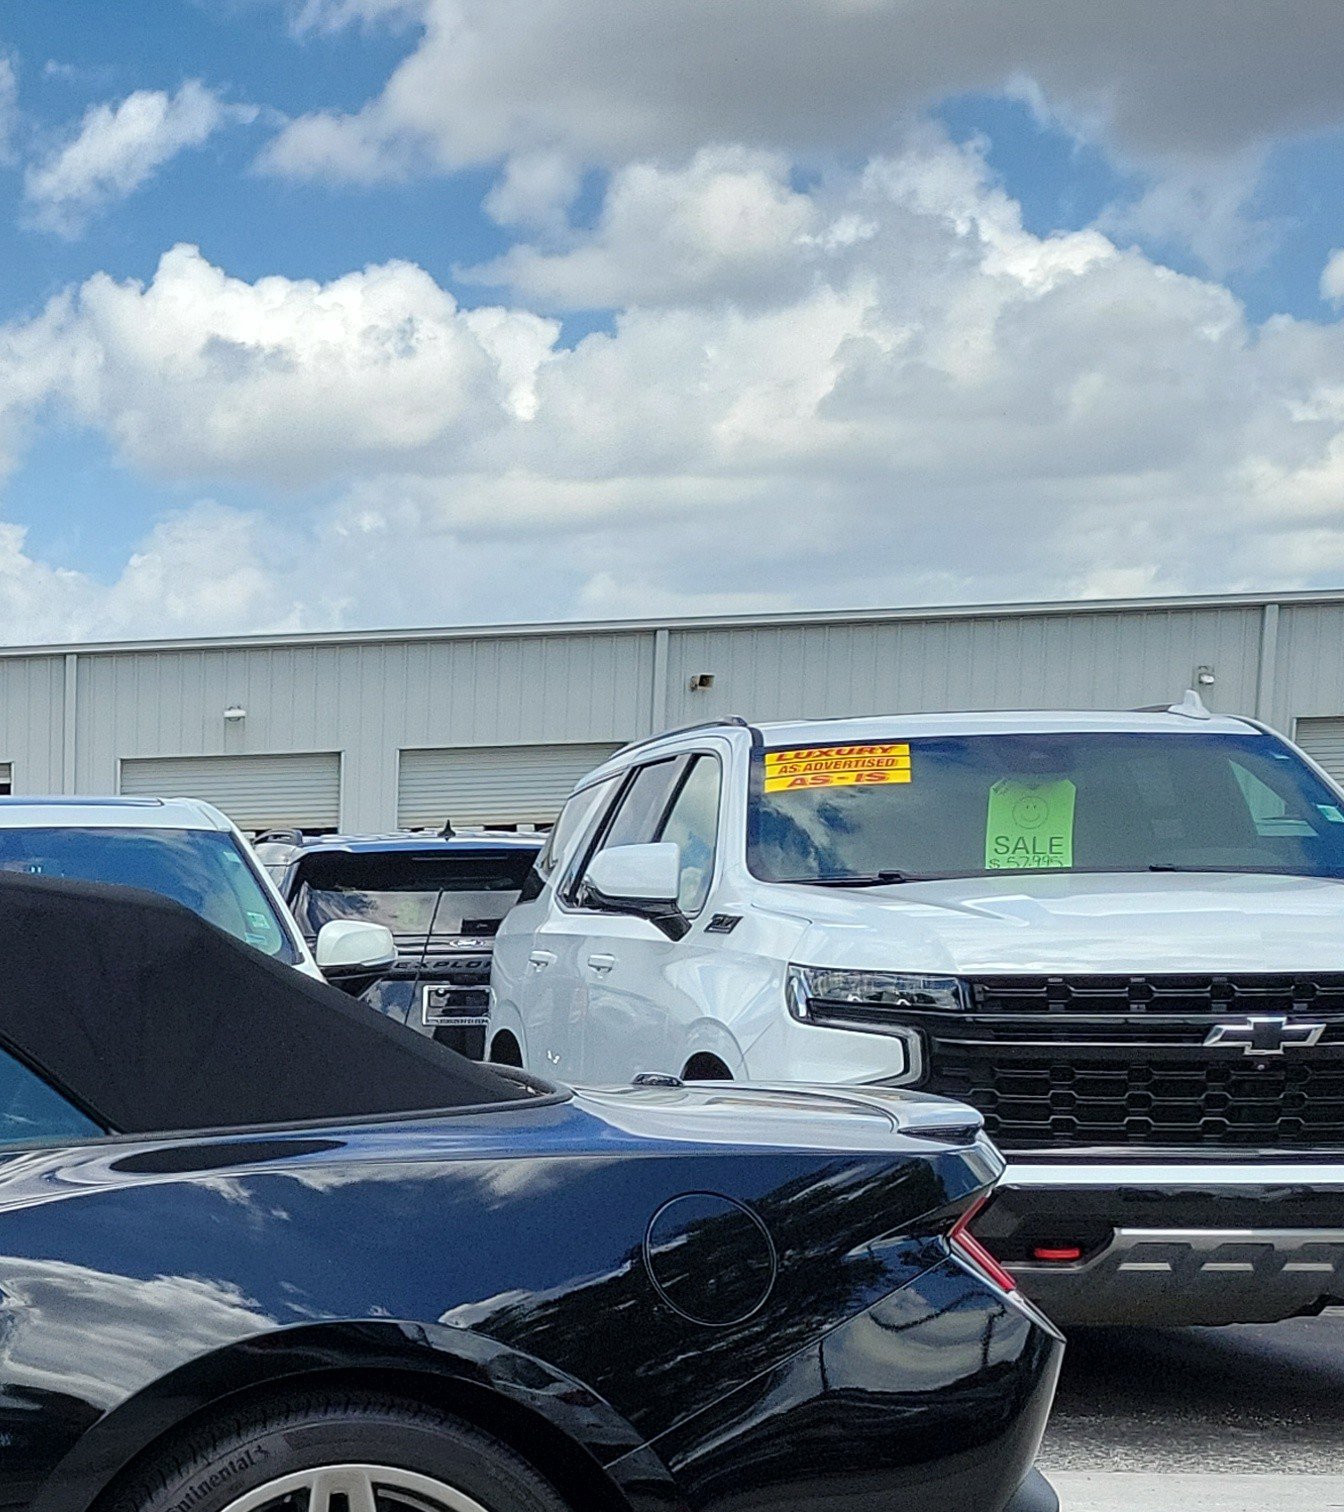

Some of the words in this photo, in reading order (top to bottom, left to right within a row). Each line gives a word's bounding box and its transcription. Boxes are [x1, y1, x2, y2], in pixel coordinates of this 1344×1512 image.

[776, 746, 898, 762] LUXURY
[803, 758, 895, 772] ADVERTISED
[787, 772, 889, 788] AS-IS
[994, 835, 1064, 855] SALE
